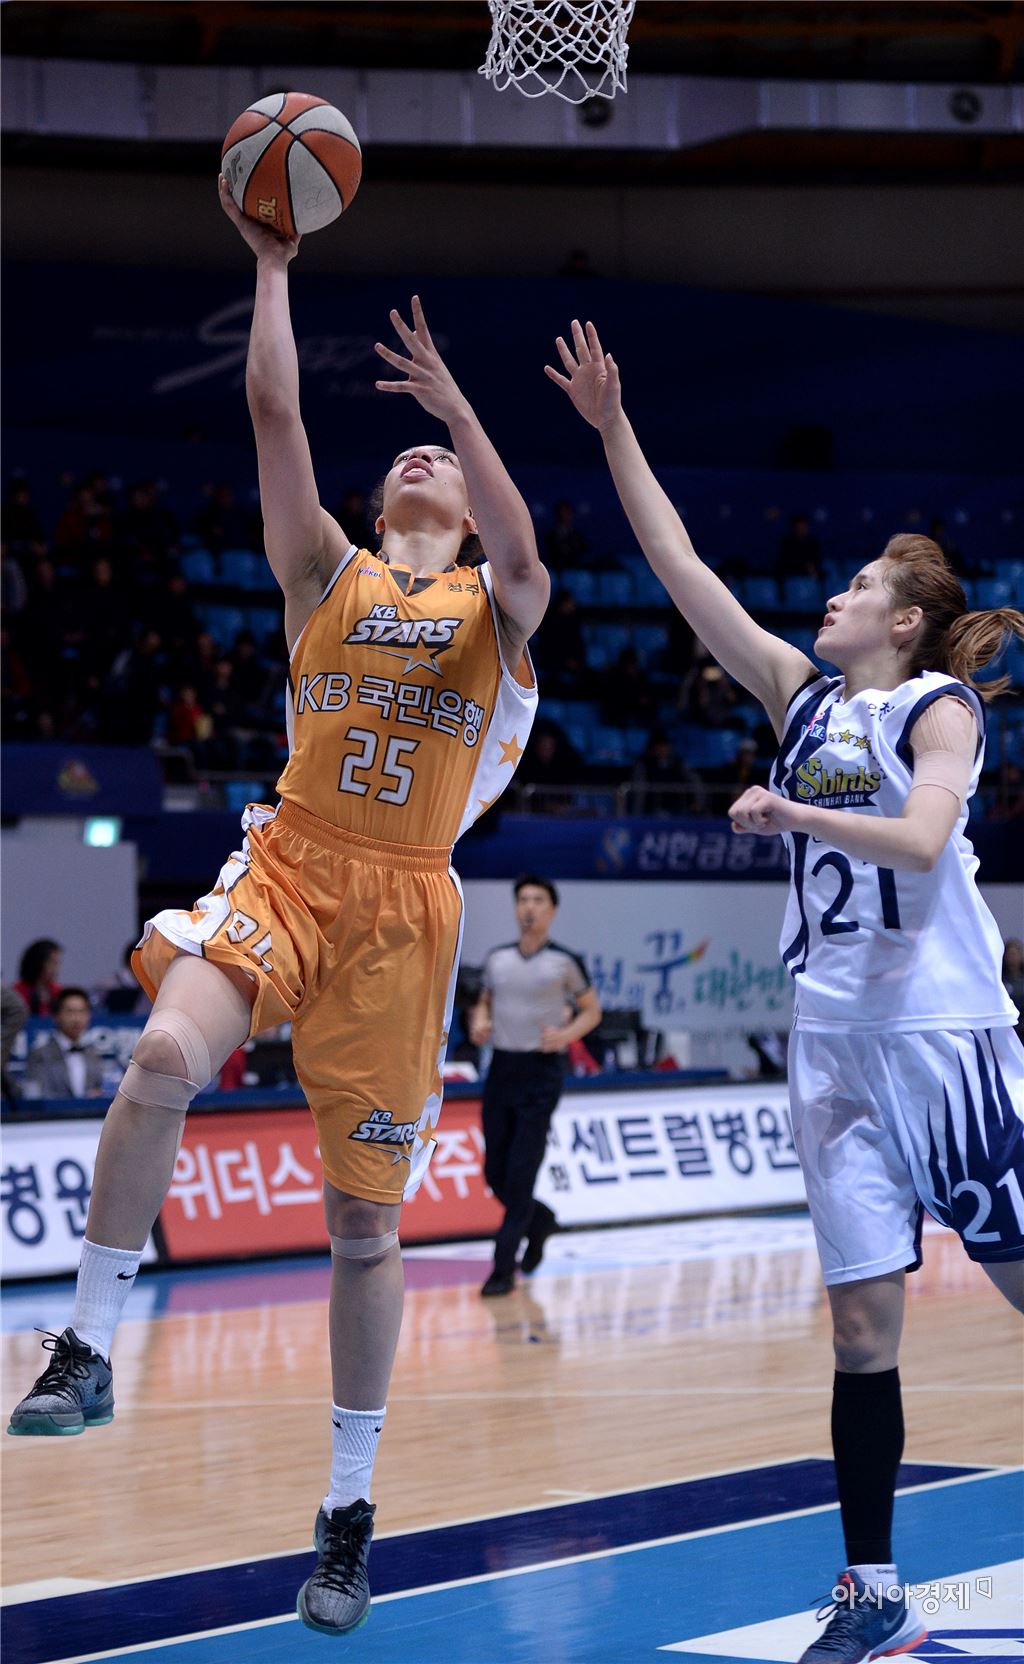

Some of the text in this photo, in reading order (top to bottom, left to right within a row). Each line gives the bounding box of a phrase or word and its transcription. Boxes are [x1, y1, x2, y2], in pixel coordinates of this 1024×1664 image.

[342, 617, 464, 648] STARS
[369, 604, 398, 620] KB
[297, 672, 486, 748] KB 국민은행
[337, 726, 421, 807] 25
[844, 794, 865, 804] BANK
[637, 829, 789, 873] 신한금융그
[811, 851, 901, 936] 21
[369, 1109, 393, 1124] KB
[571, 1105, 801, 1186] 센트럴병원
[168, 1139, 322, 1221] 위더스
[951, 1167, 1024, 1243] 21
